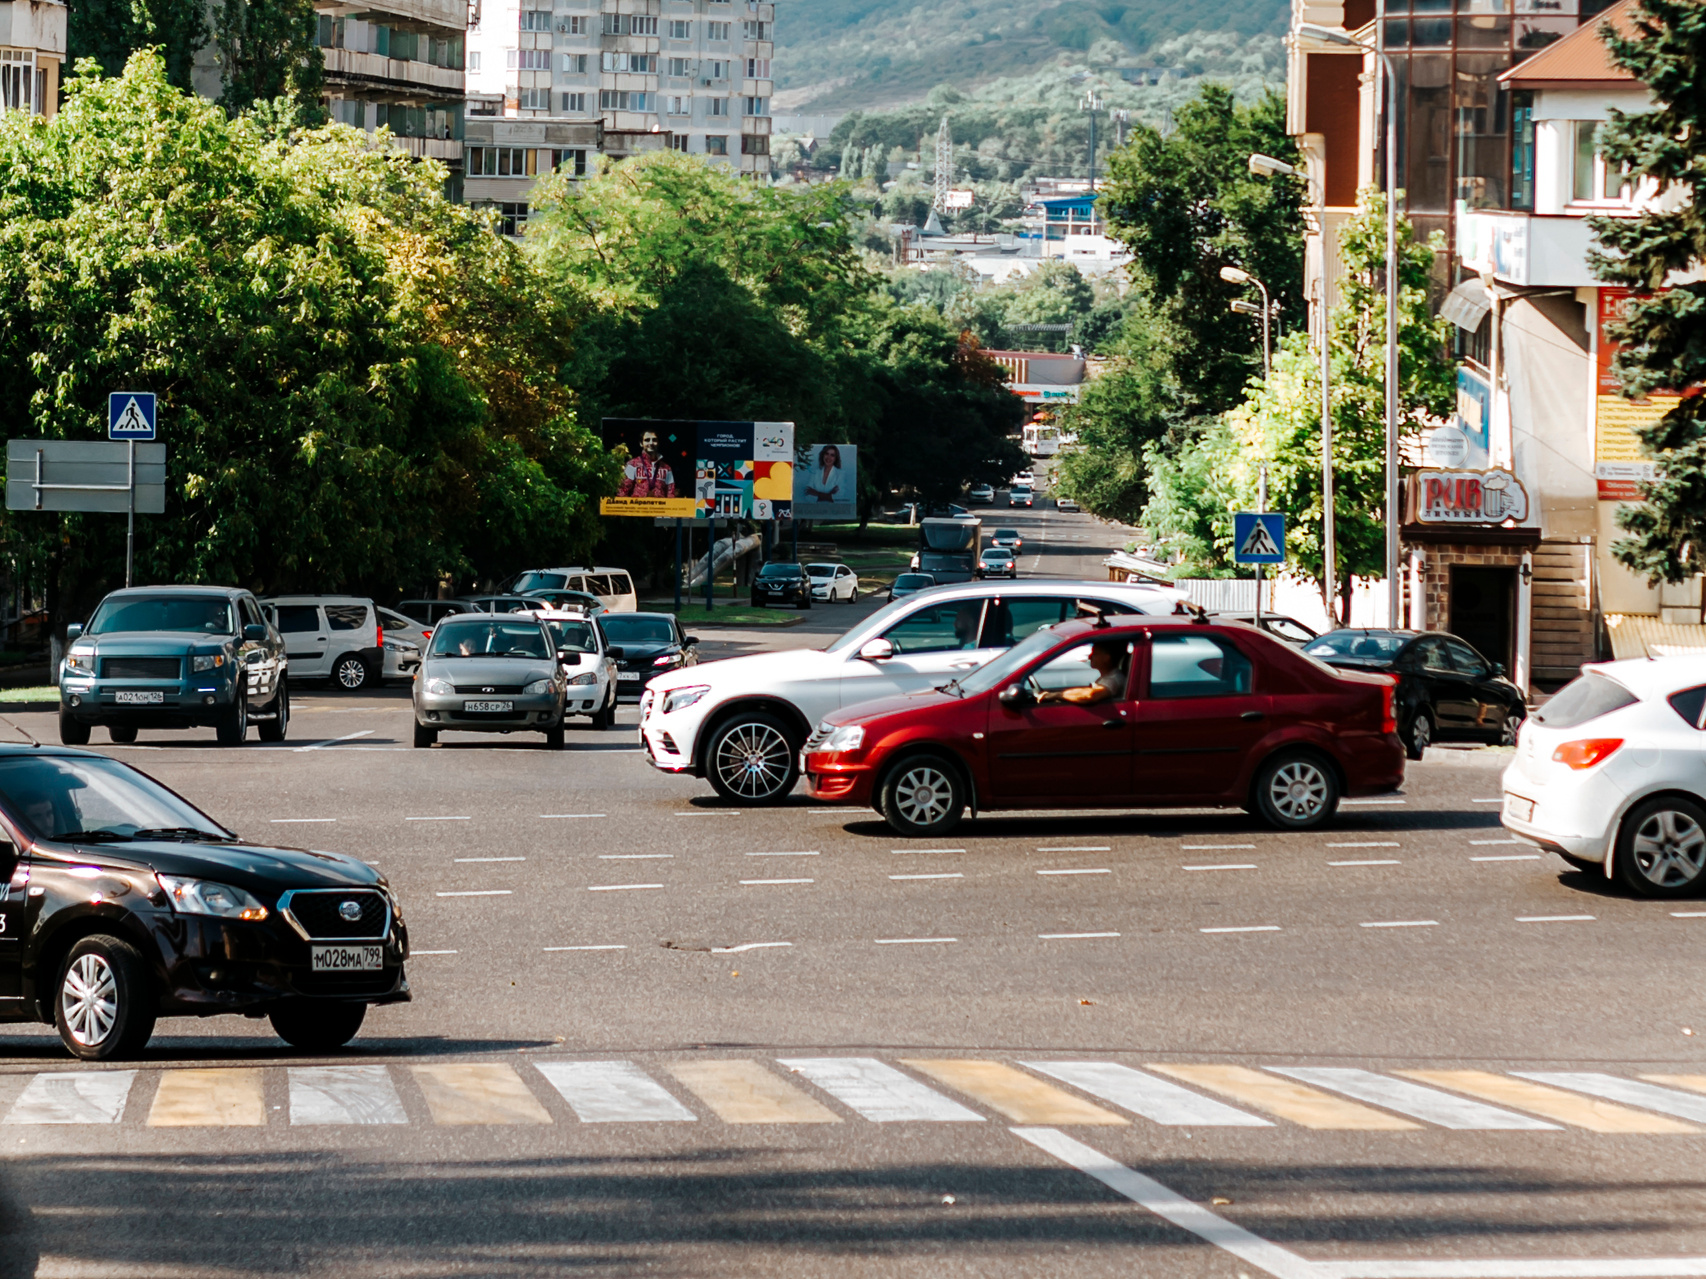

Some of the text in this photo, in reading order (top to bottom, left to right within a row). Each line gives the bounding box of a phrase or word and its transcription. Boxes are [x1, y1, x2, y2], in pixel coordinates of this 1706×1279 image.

[1424, 477, 1482, 510] PUB
[315, 947, 380, 968] М028МА 799
